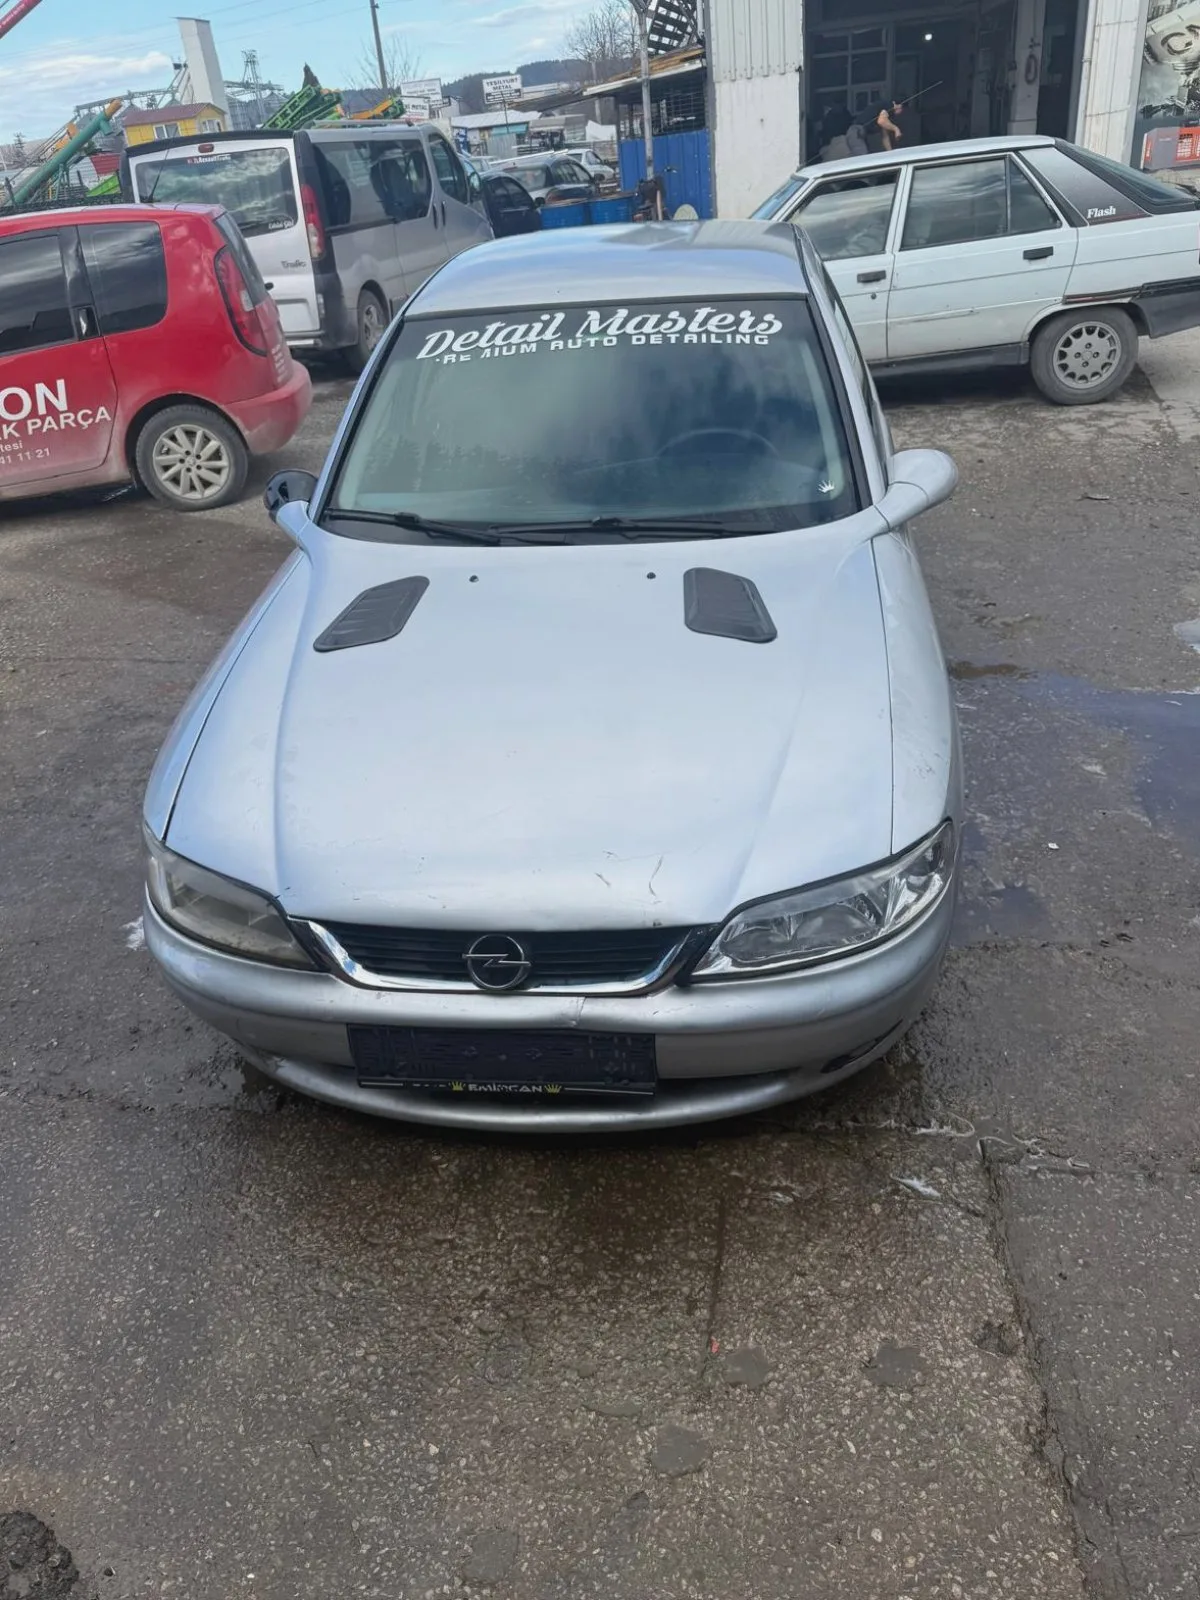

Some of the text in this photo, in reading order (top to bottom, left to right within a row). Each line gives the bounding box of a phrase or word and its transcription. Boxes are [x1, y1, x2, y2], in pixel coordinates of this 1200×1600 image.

[1087, 205, 1117, 219] Flash
[416, 307, 783, 359] Detail Masters
[550, 337, 617, 351] AUTO
[631, 333, 769, 345] DETAILING
[27, 406, 111, 436] PARÇA
[17, 452, 31, 462] 11
[35, 447, 50, 459] 21
